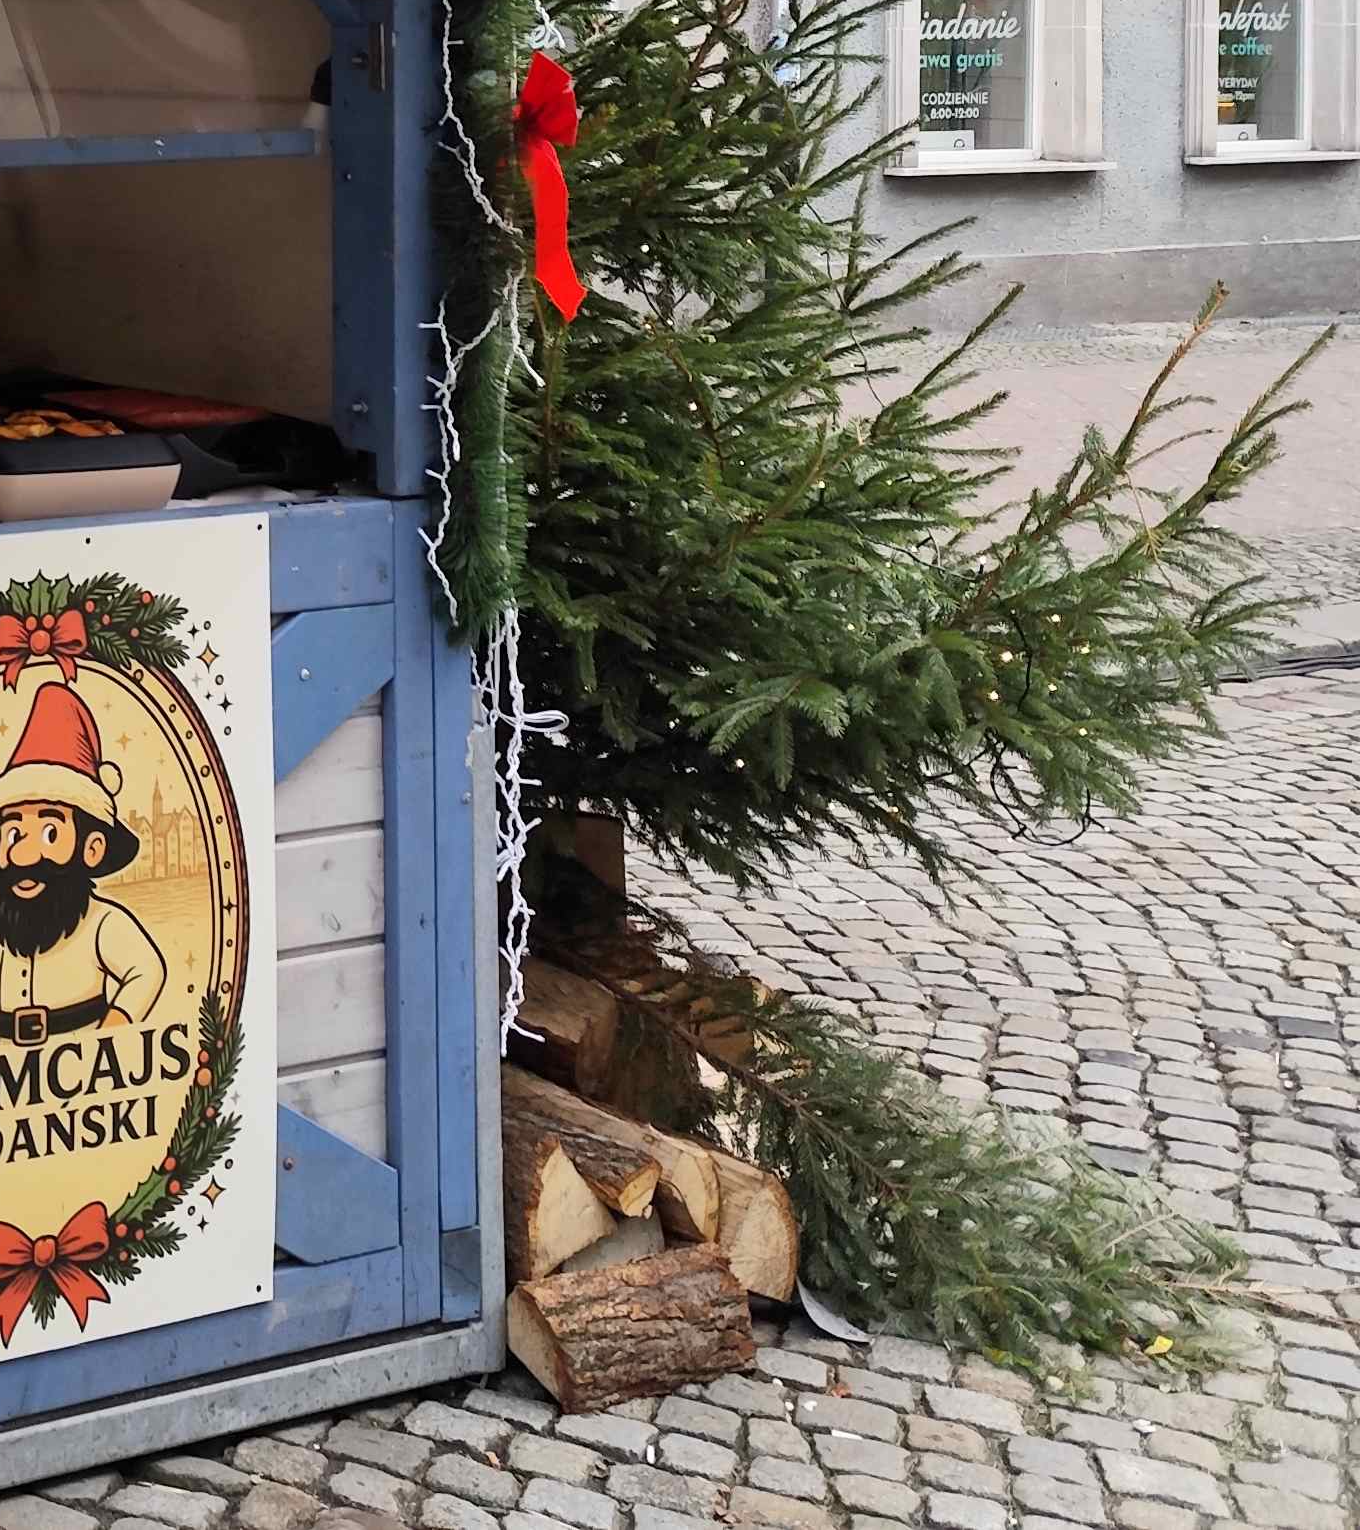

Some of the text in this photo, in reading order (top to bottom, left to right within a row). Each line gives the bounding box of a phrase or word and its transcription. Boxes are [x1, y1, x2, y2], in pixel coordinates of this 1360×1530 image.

[920, 3, 1022, 40] iadanie
[1231, 37, 1273, 56] coffee
[920, 48, 1004, 74] awa gratis
[1219, 77, 1259, 89] VERYDAY
[922, 92, 990, 106] CODZIENNIE
[930, 107, 980, 120] 8:00-12:00
